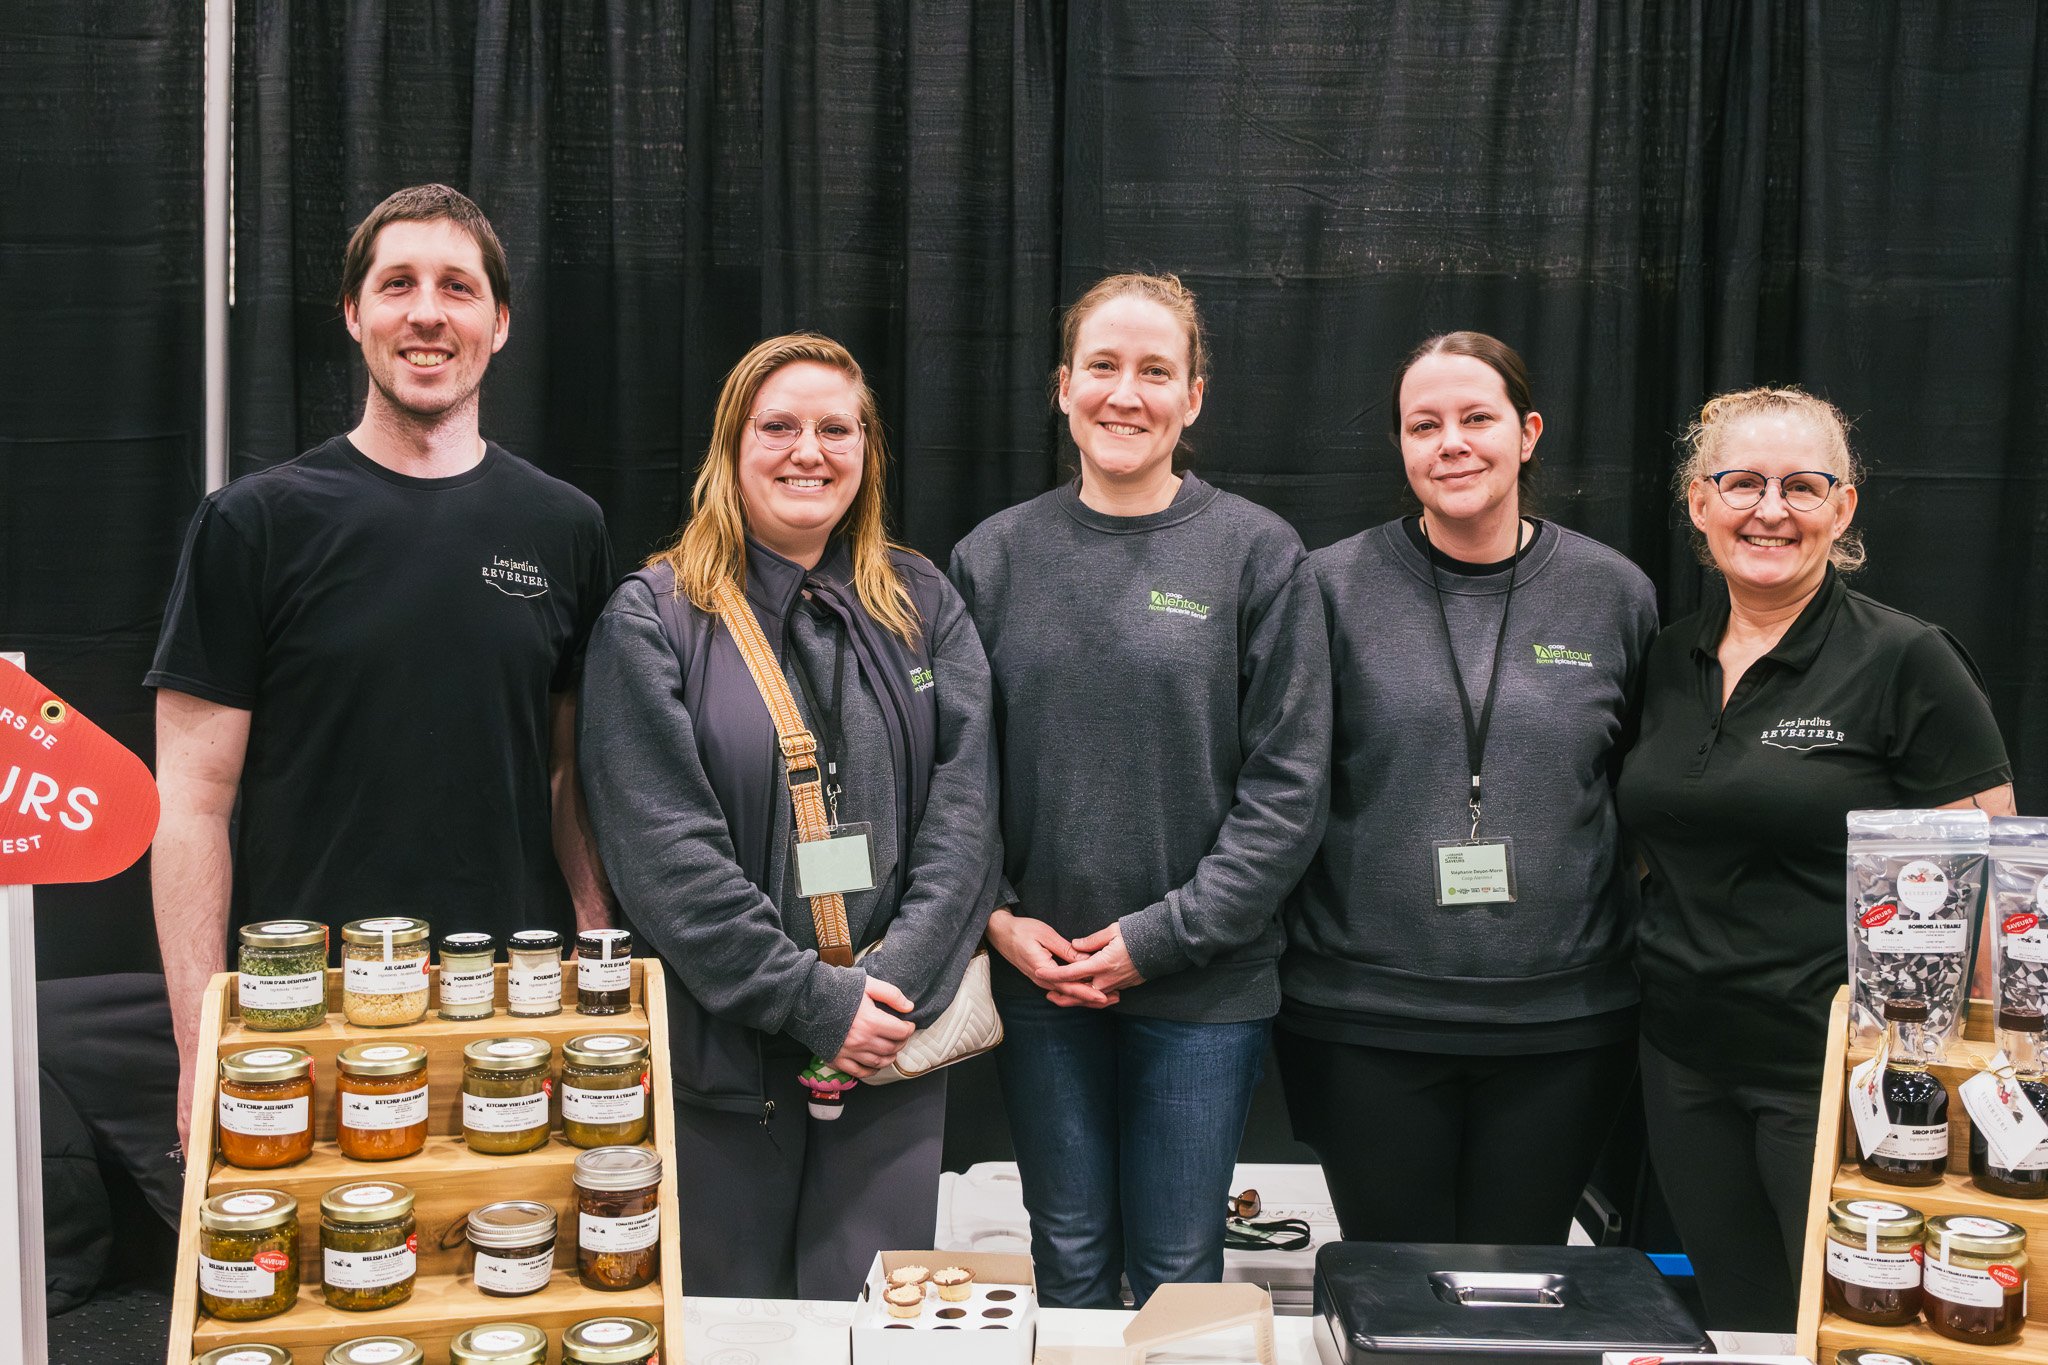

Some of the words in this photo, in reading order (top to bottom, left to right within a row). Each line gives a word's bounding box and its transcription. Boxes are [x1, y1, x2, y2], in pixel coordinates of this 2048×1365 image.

[494, 555, 509, 567] Les
[510, 558, 538, 573] jardins
[0, 706, 28, 731] RS
[29, 724, 58, 750] DE
[1777, 719, 1795, 727] Les
[1795, 716, 1831, 728] jardins
[1760, 728, 1845, 742] REVERTERE
[0, 835, 42, 854] EST
[1865, 908, 1893, 925] SAVEURS
[2006, 917, 2034, 931] SAVEURS
[260, 1257, 287, 1267] SAVEURS
[1993, 1268, 2019, 1284] SAVEURS
